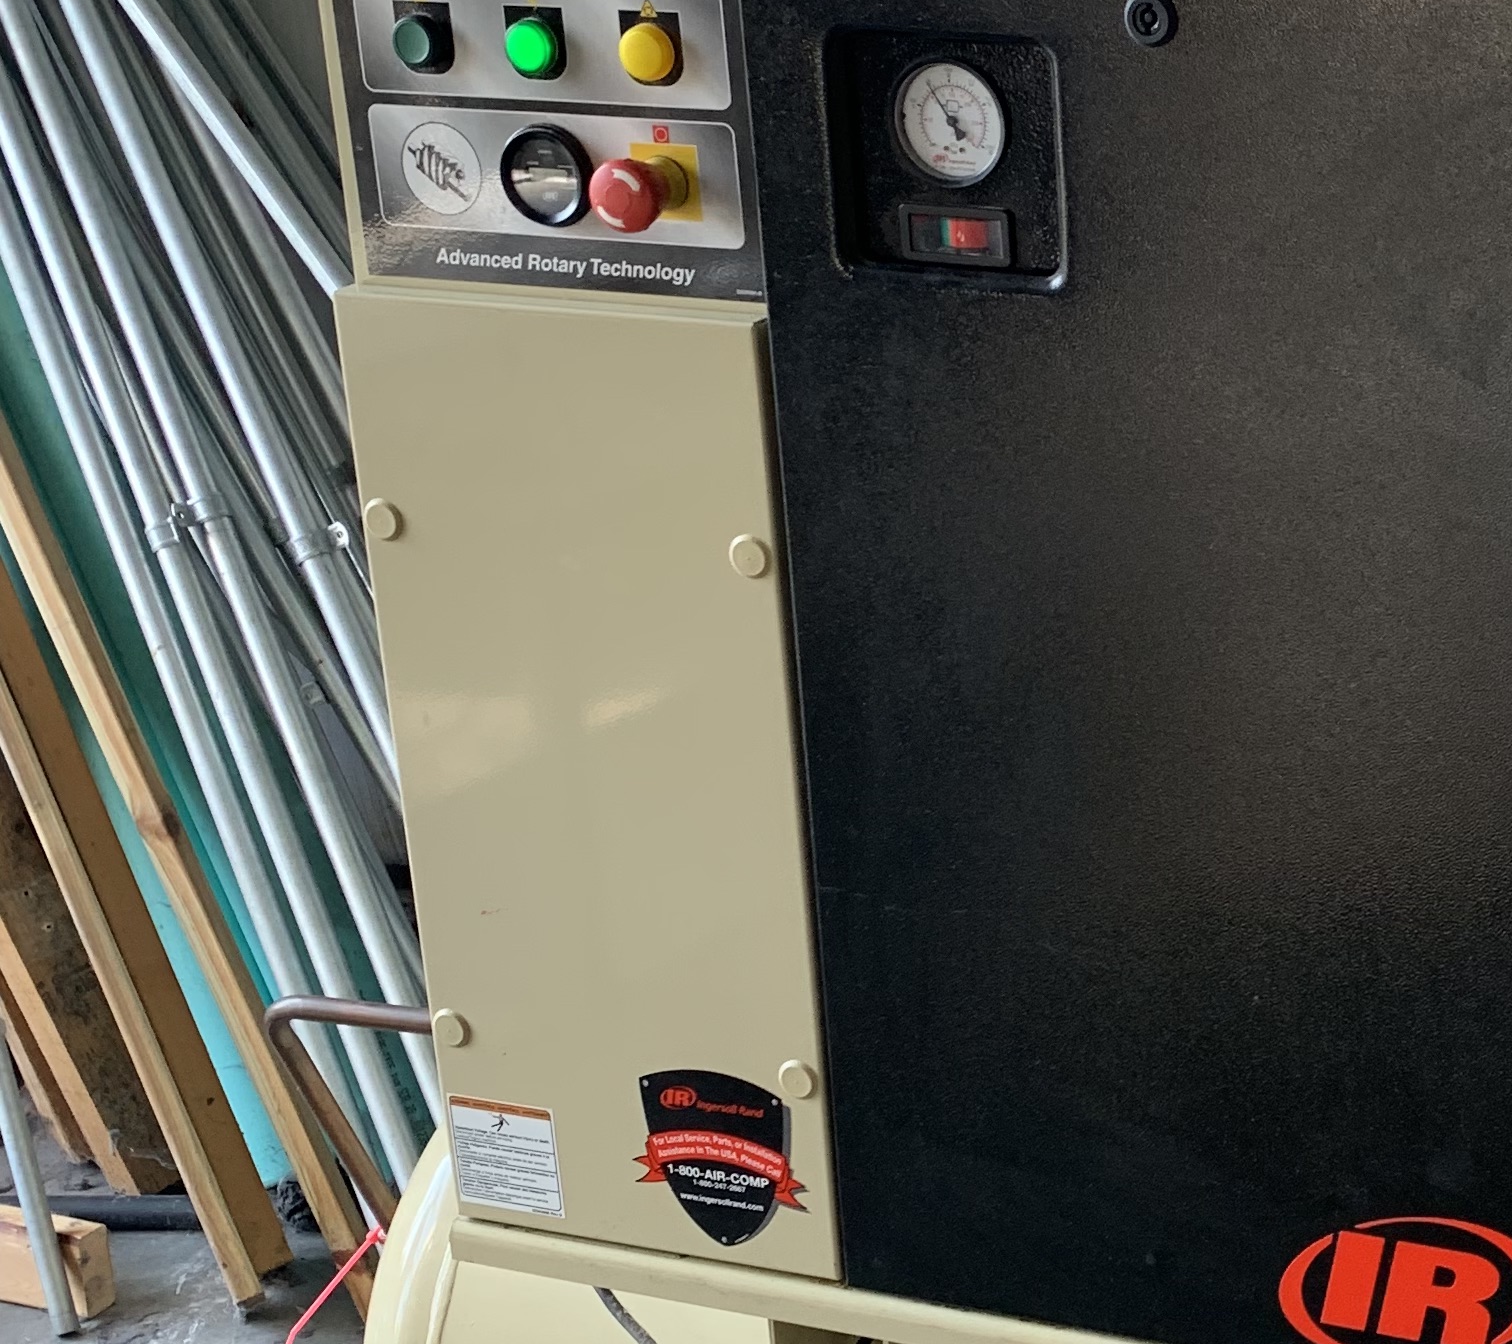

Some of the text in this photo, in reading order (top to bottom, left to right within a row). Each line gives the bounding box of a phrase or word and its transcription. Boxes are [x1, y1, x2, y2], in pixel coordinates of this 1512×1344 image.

[436, 248, 696, 286] Advanced Rotary Technology
[664, 1088, 764, 1119] IR Ingersoll Rand
[652, 1137, 665, 1146] For
[665, 1135, 683, 1144] Local
[684, 1134, 712, 1144] Service,
[743, 1142, 782, 1165] Installation
[705, 1146, 720, 1156] The
[740, 1154, 766, 1171] Please
[766, 1165, 783, 1178] Call
[667, 1163, 769, 1189] 1-800-AIR-COMP
[680, 1192, 765, 1212] www.ingersollrand.com
